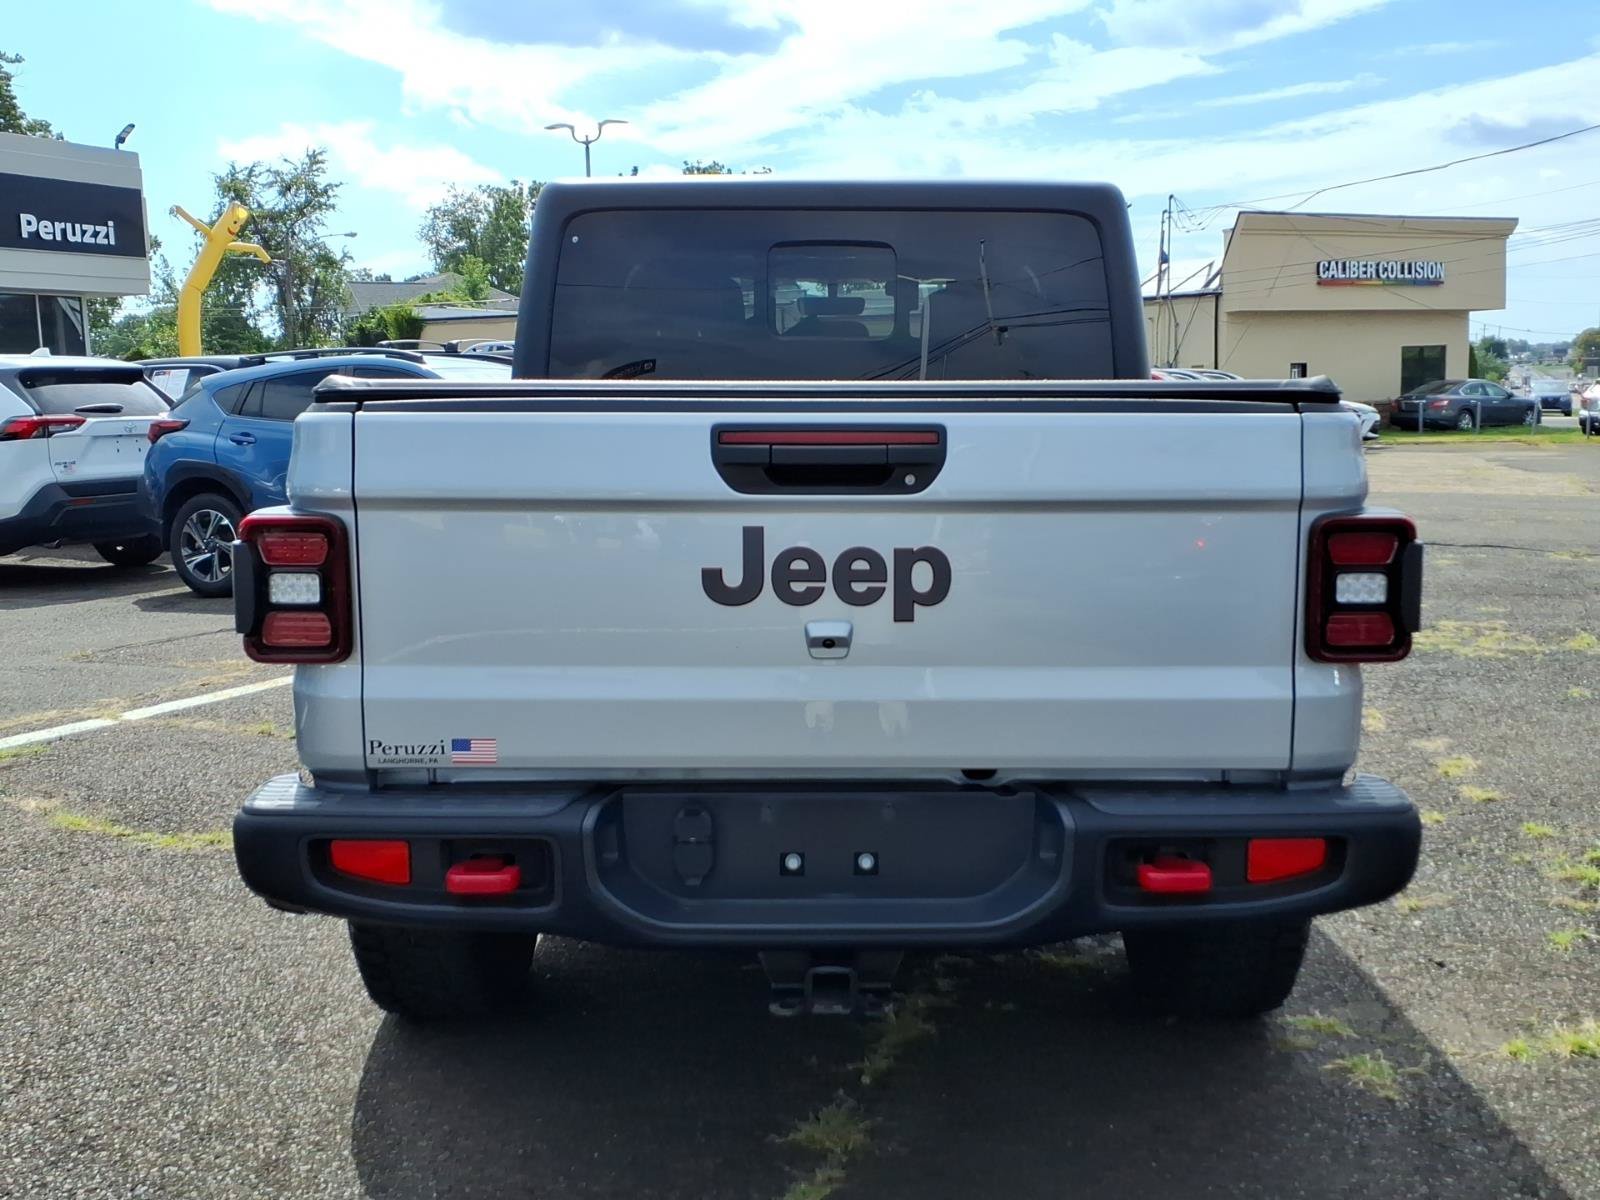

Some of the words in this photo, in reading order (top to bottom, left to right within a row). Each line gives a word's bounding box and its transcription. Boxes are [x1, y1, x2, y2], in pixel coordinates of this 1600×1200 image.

[20, 213, 115, 245] Peruzzi
[1317, 260, 1376, 279] CALIBER
[1378, 261, 1445, 280] COLLISION
[701, 526, 952, 622] Jeep
[369, 739, 446, 755] Peruzzi
